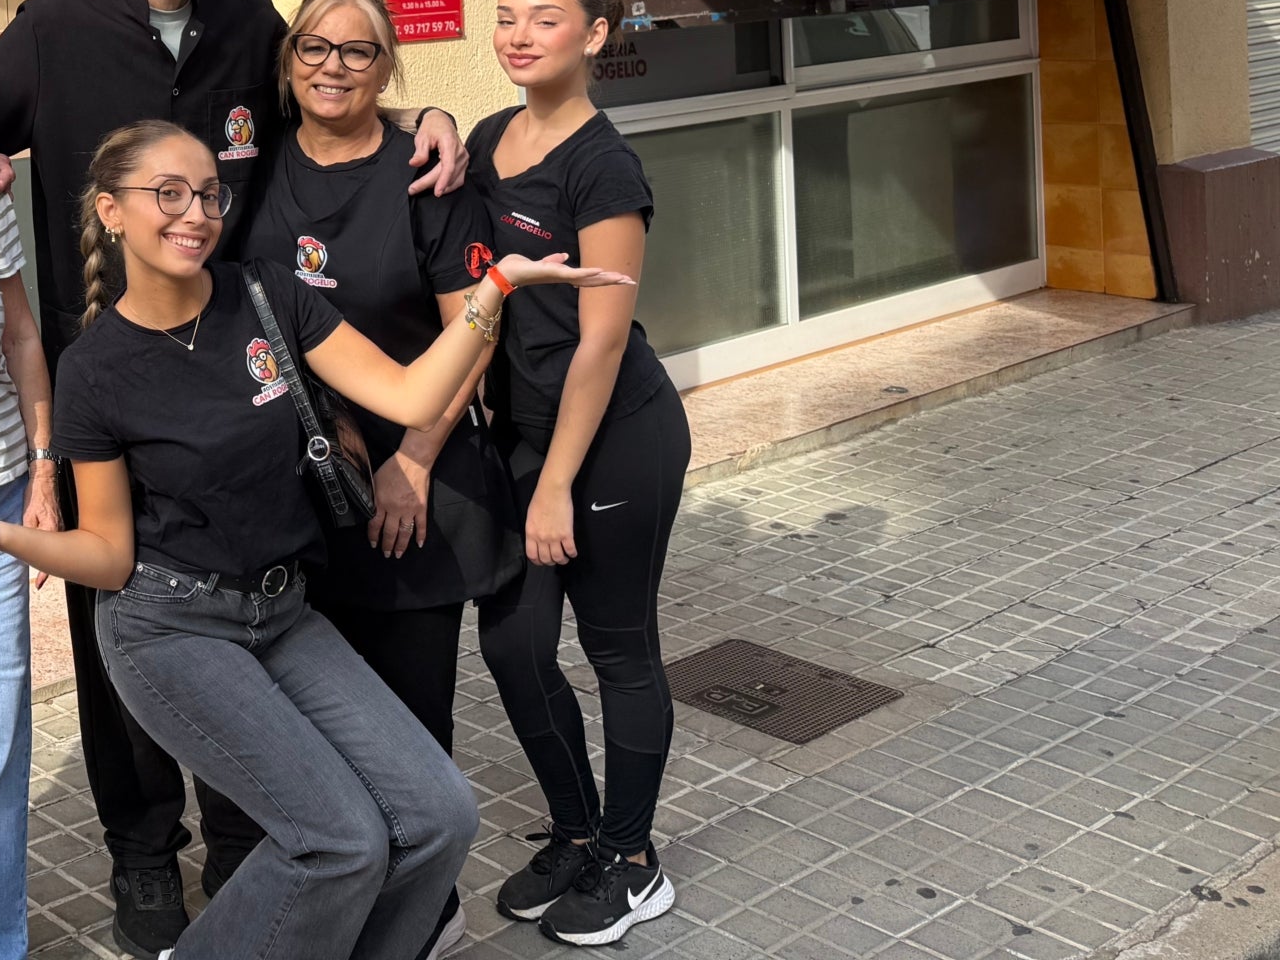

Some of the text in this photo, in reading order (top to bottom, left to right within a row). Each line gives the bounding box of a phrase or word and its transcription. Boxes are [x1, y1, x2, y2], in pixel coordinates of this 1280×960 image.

[403, 23, 415, 35] 93
[416, 22, 431, 34] 717
[432, 20, 443, 32] 59
[444, 20, 455, 32] 70
[219, 151, 234, 159] CAN
[515, 220, 553, 240] ROGELIO
[254, 392, 272, 405] CAN
